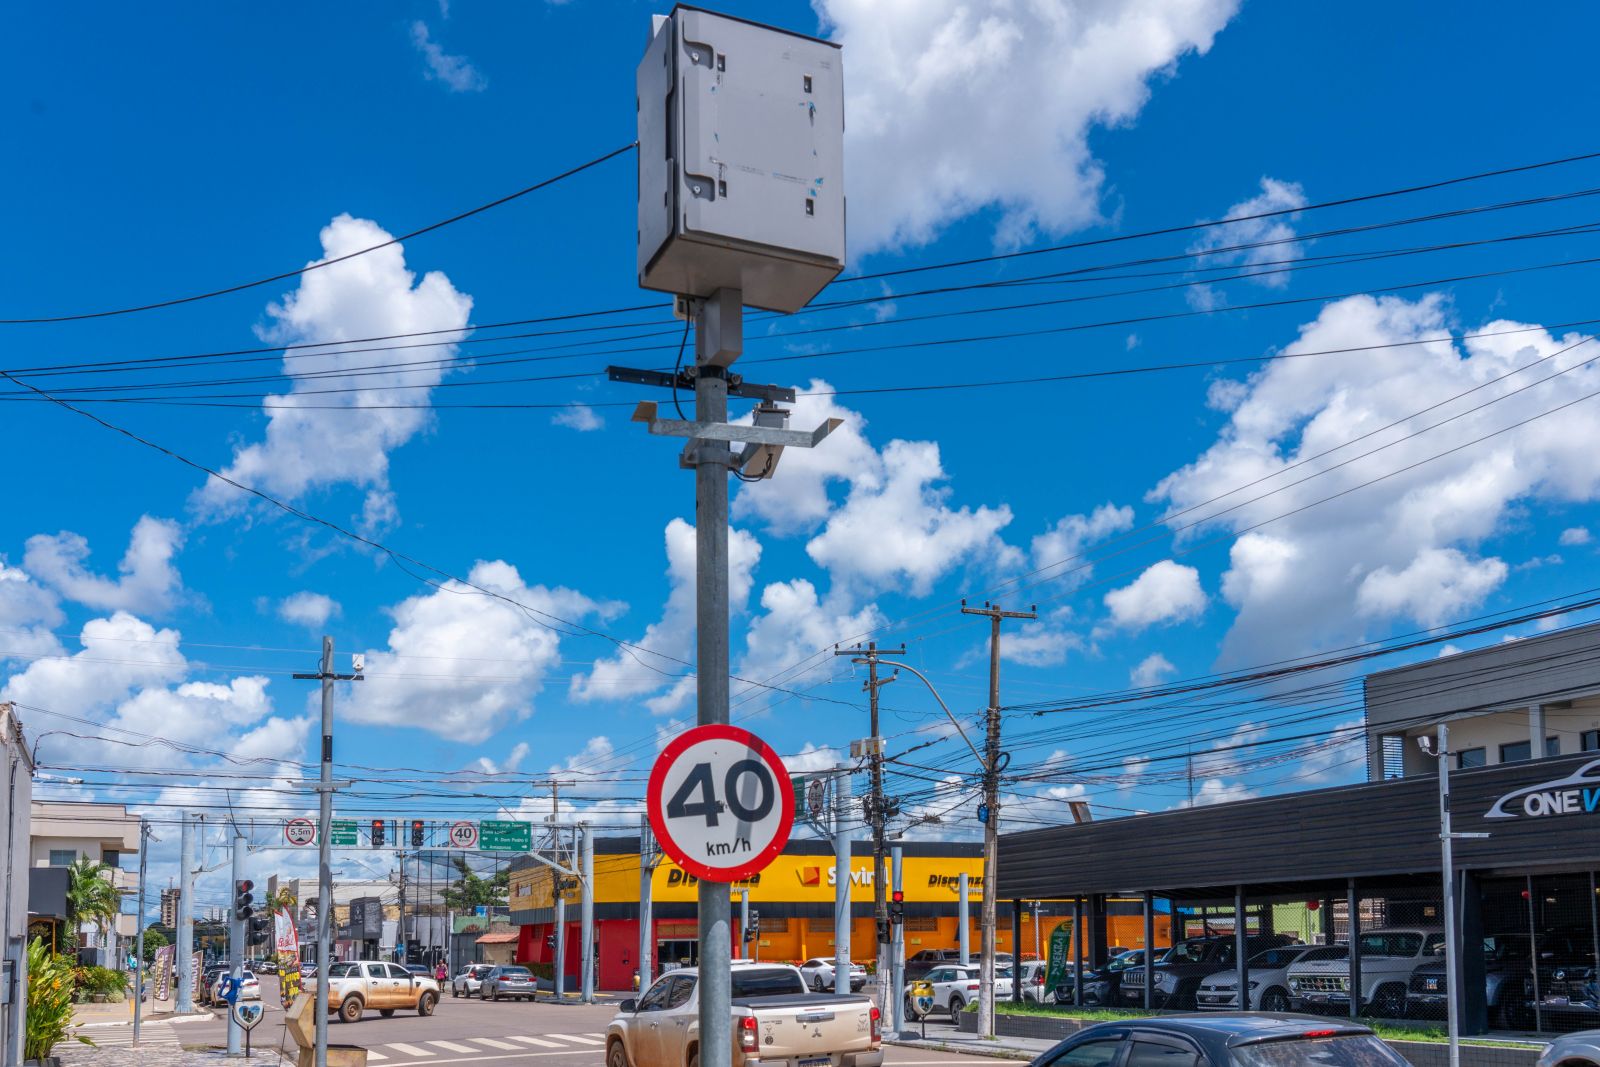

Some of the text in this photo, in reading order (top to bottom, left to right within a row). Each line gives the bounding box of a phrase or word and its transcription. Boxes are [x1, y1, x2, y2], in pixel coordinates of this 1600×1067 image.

[666, 759, 775, 827] 40
[290, 828, 311, 837] 5,5m
[455, 828, 472, 839] 40
[706, 838, 752, 857] km/h
[1052, 938, 1063, 966] DEKRA
